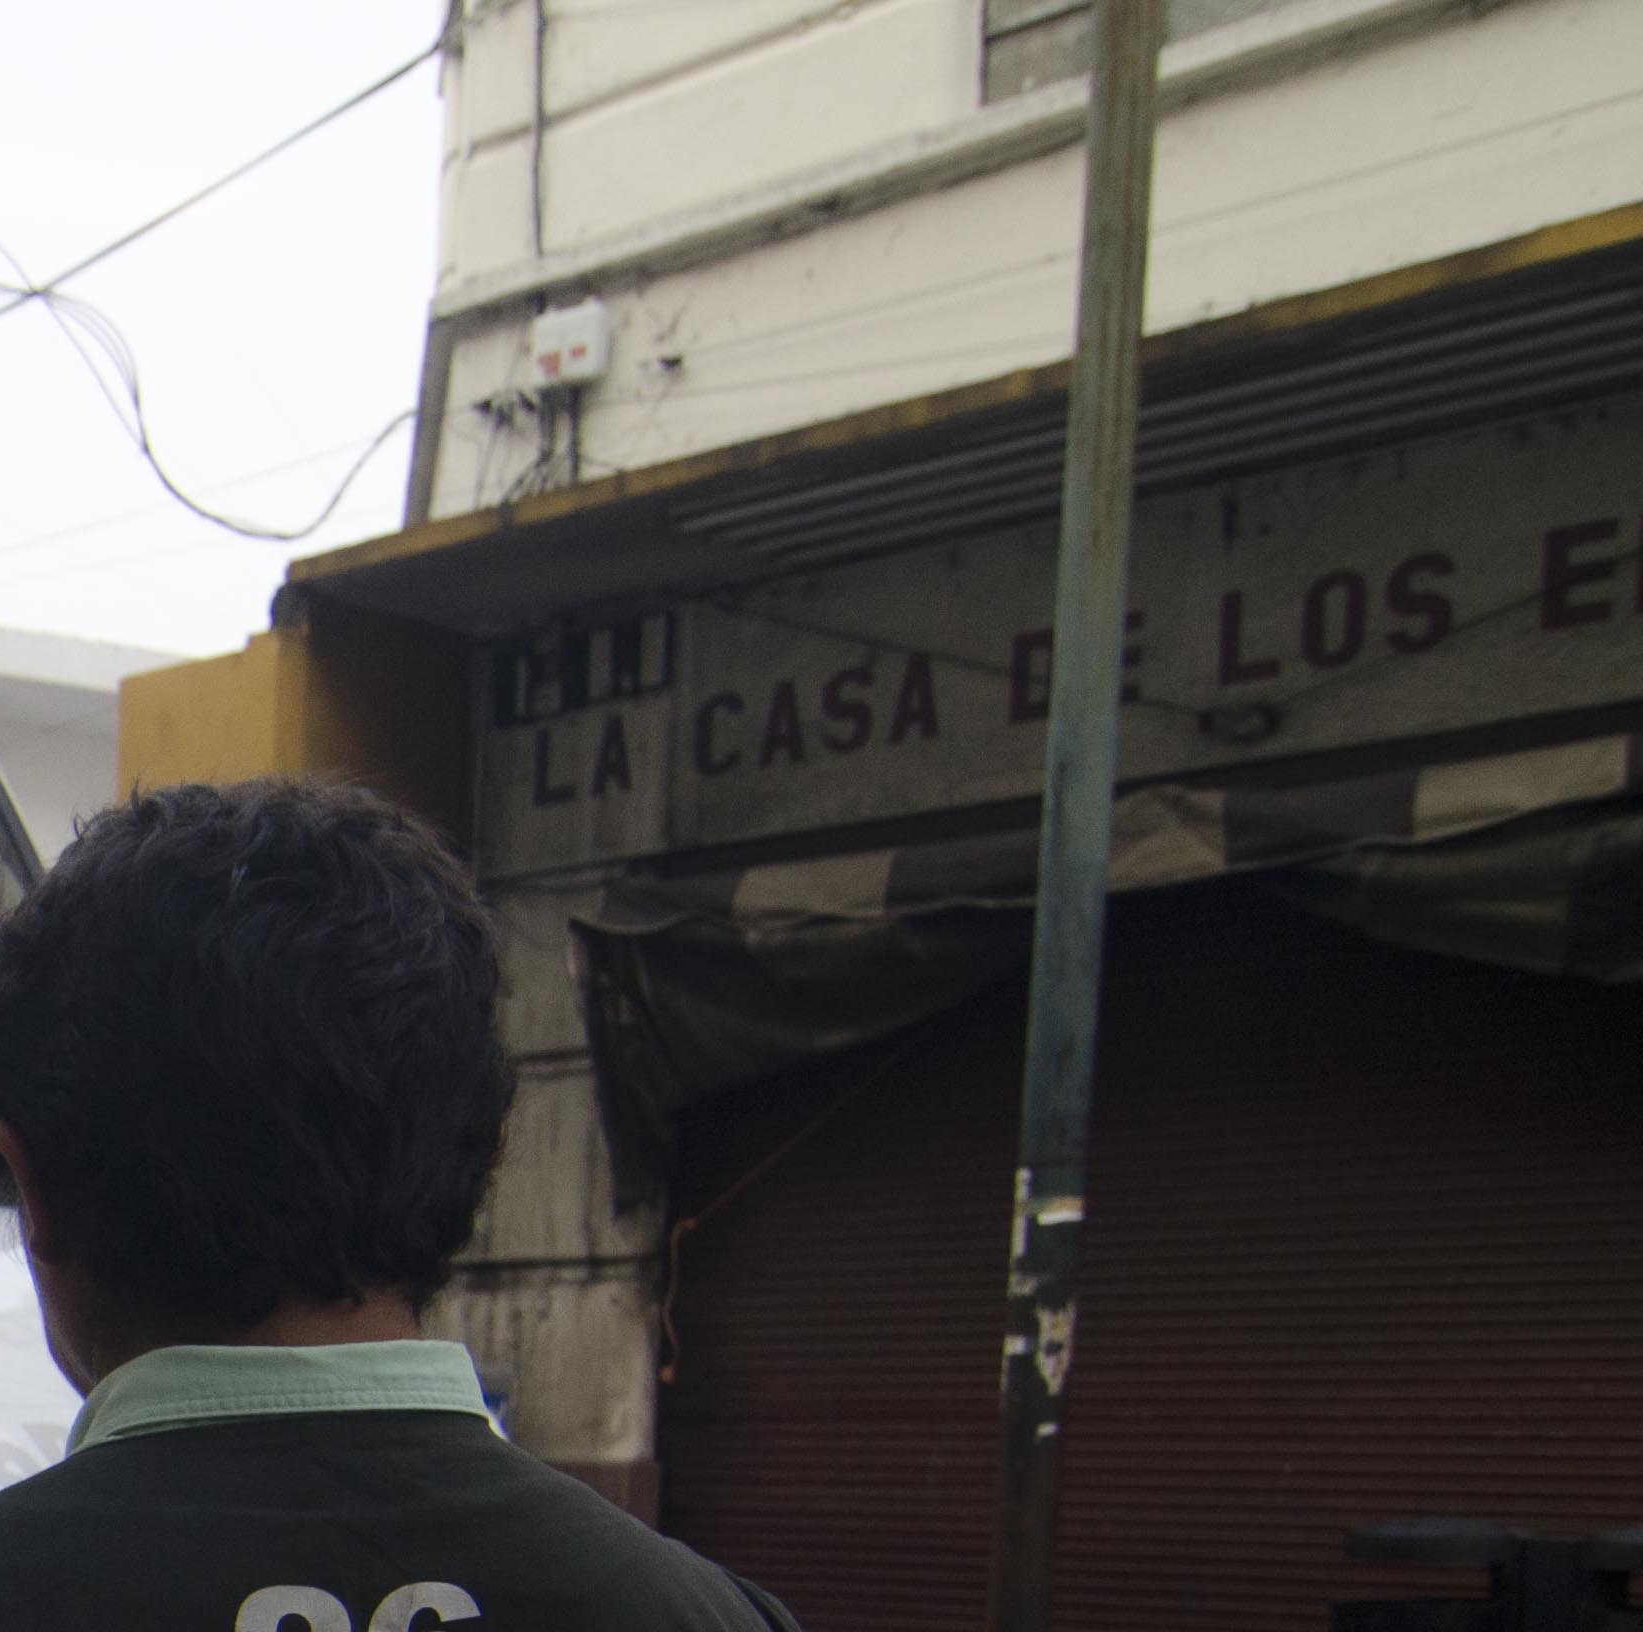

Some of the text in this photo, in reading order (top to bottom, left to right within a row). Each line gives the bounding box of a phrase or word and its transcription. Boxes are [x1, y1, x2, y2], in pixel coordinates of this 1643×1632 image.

[532, 508, 1643, 808] LA CASA D LOS E
